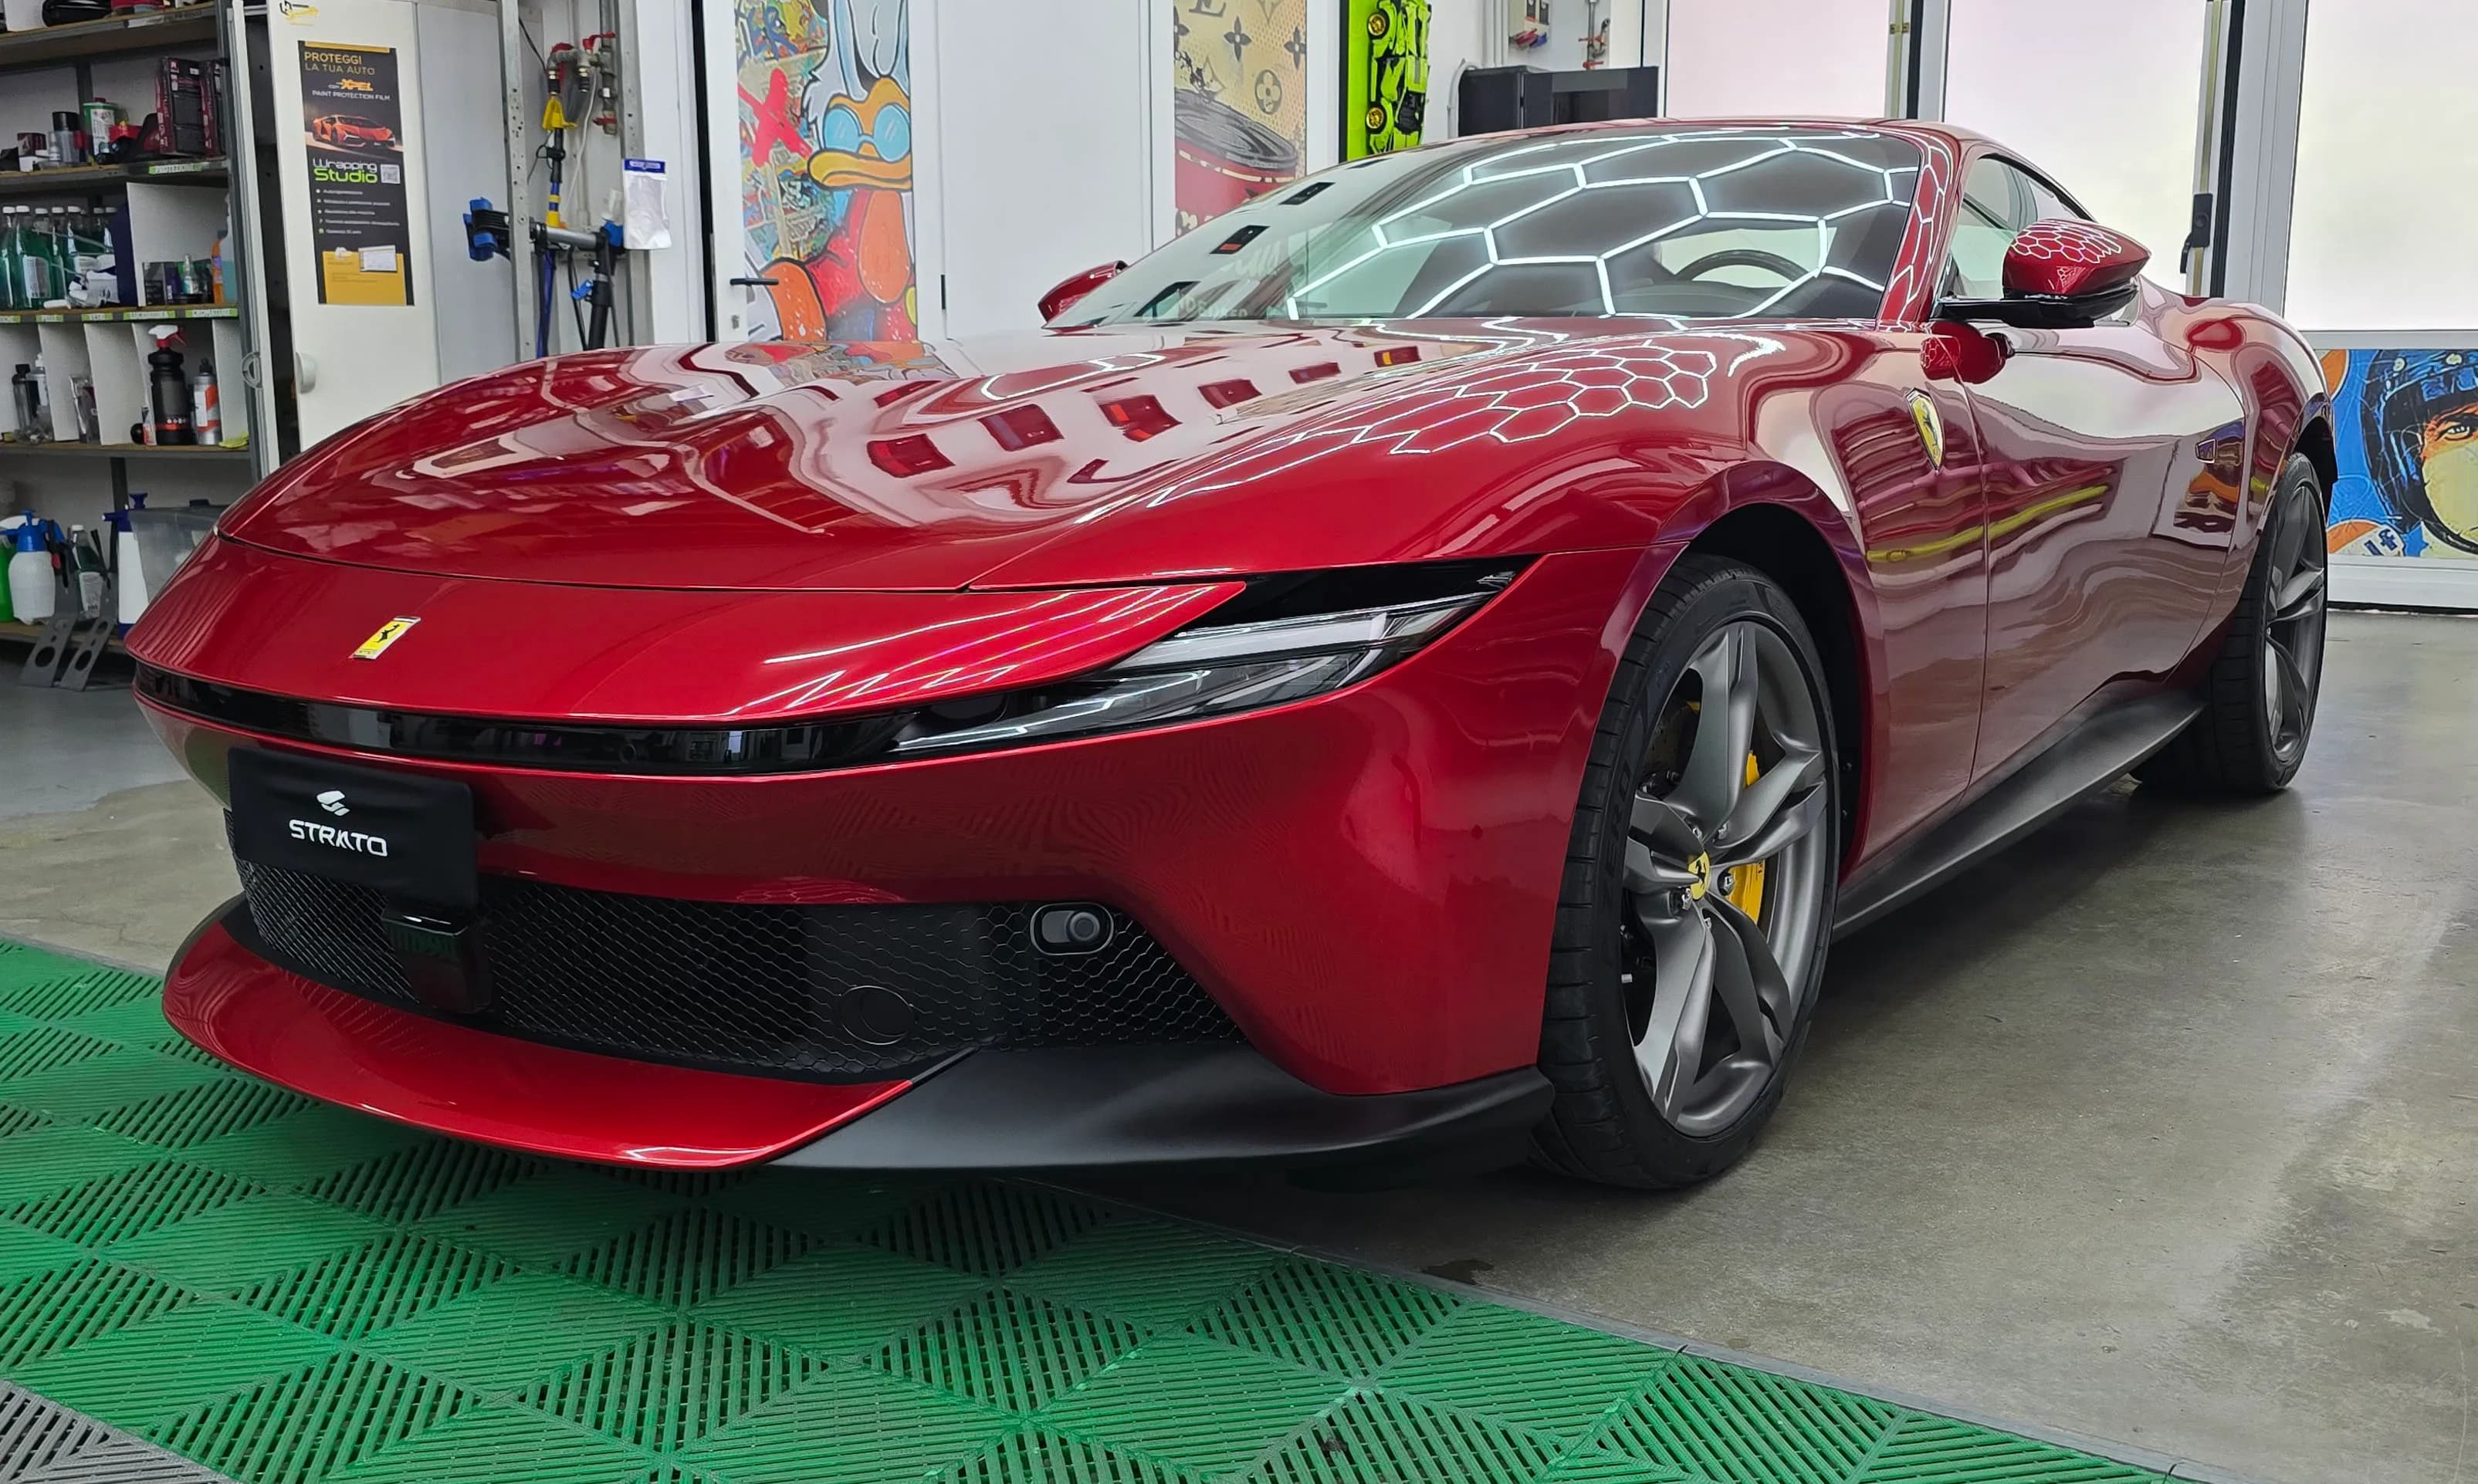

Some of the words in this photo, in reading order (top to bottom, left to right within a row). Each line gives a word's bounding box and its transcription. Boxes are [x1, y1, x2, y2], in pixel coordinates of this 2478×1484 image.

[304, 52, 362, 65] PROTEGGI
[305, 63, 319, 71] LA
[323, 64, 344, 74] TUA
[347, 66, 375, 76] AUTO
[337, 78, 374, 92] XPEL
[333, 91, 374, 100] PROTECTION
[313, 158, 377, 173] Wrapping
[313, 167, 378, 184] Studio
[289, 819, 388, 857] STRATO
